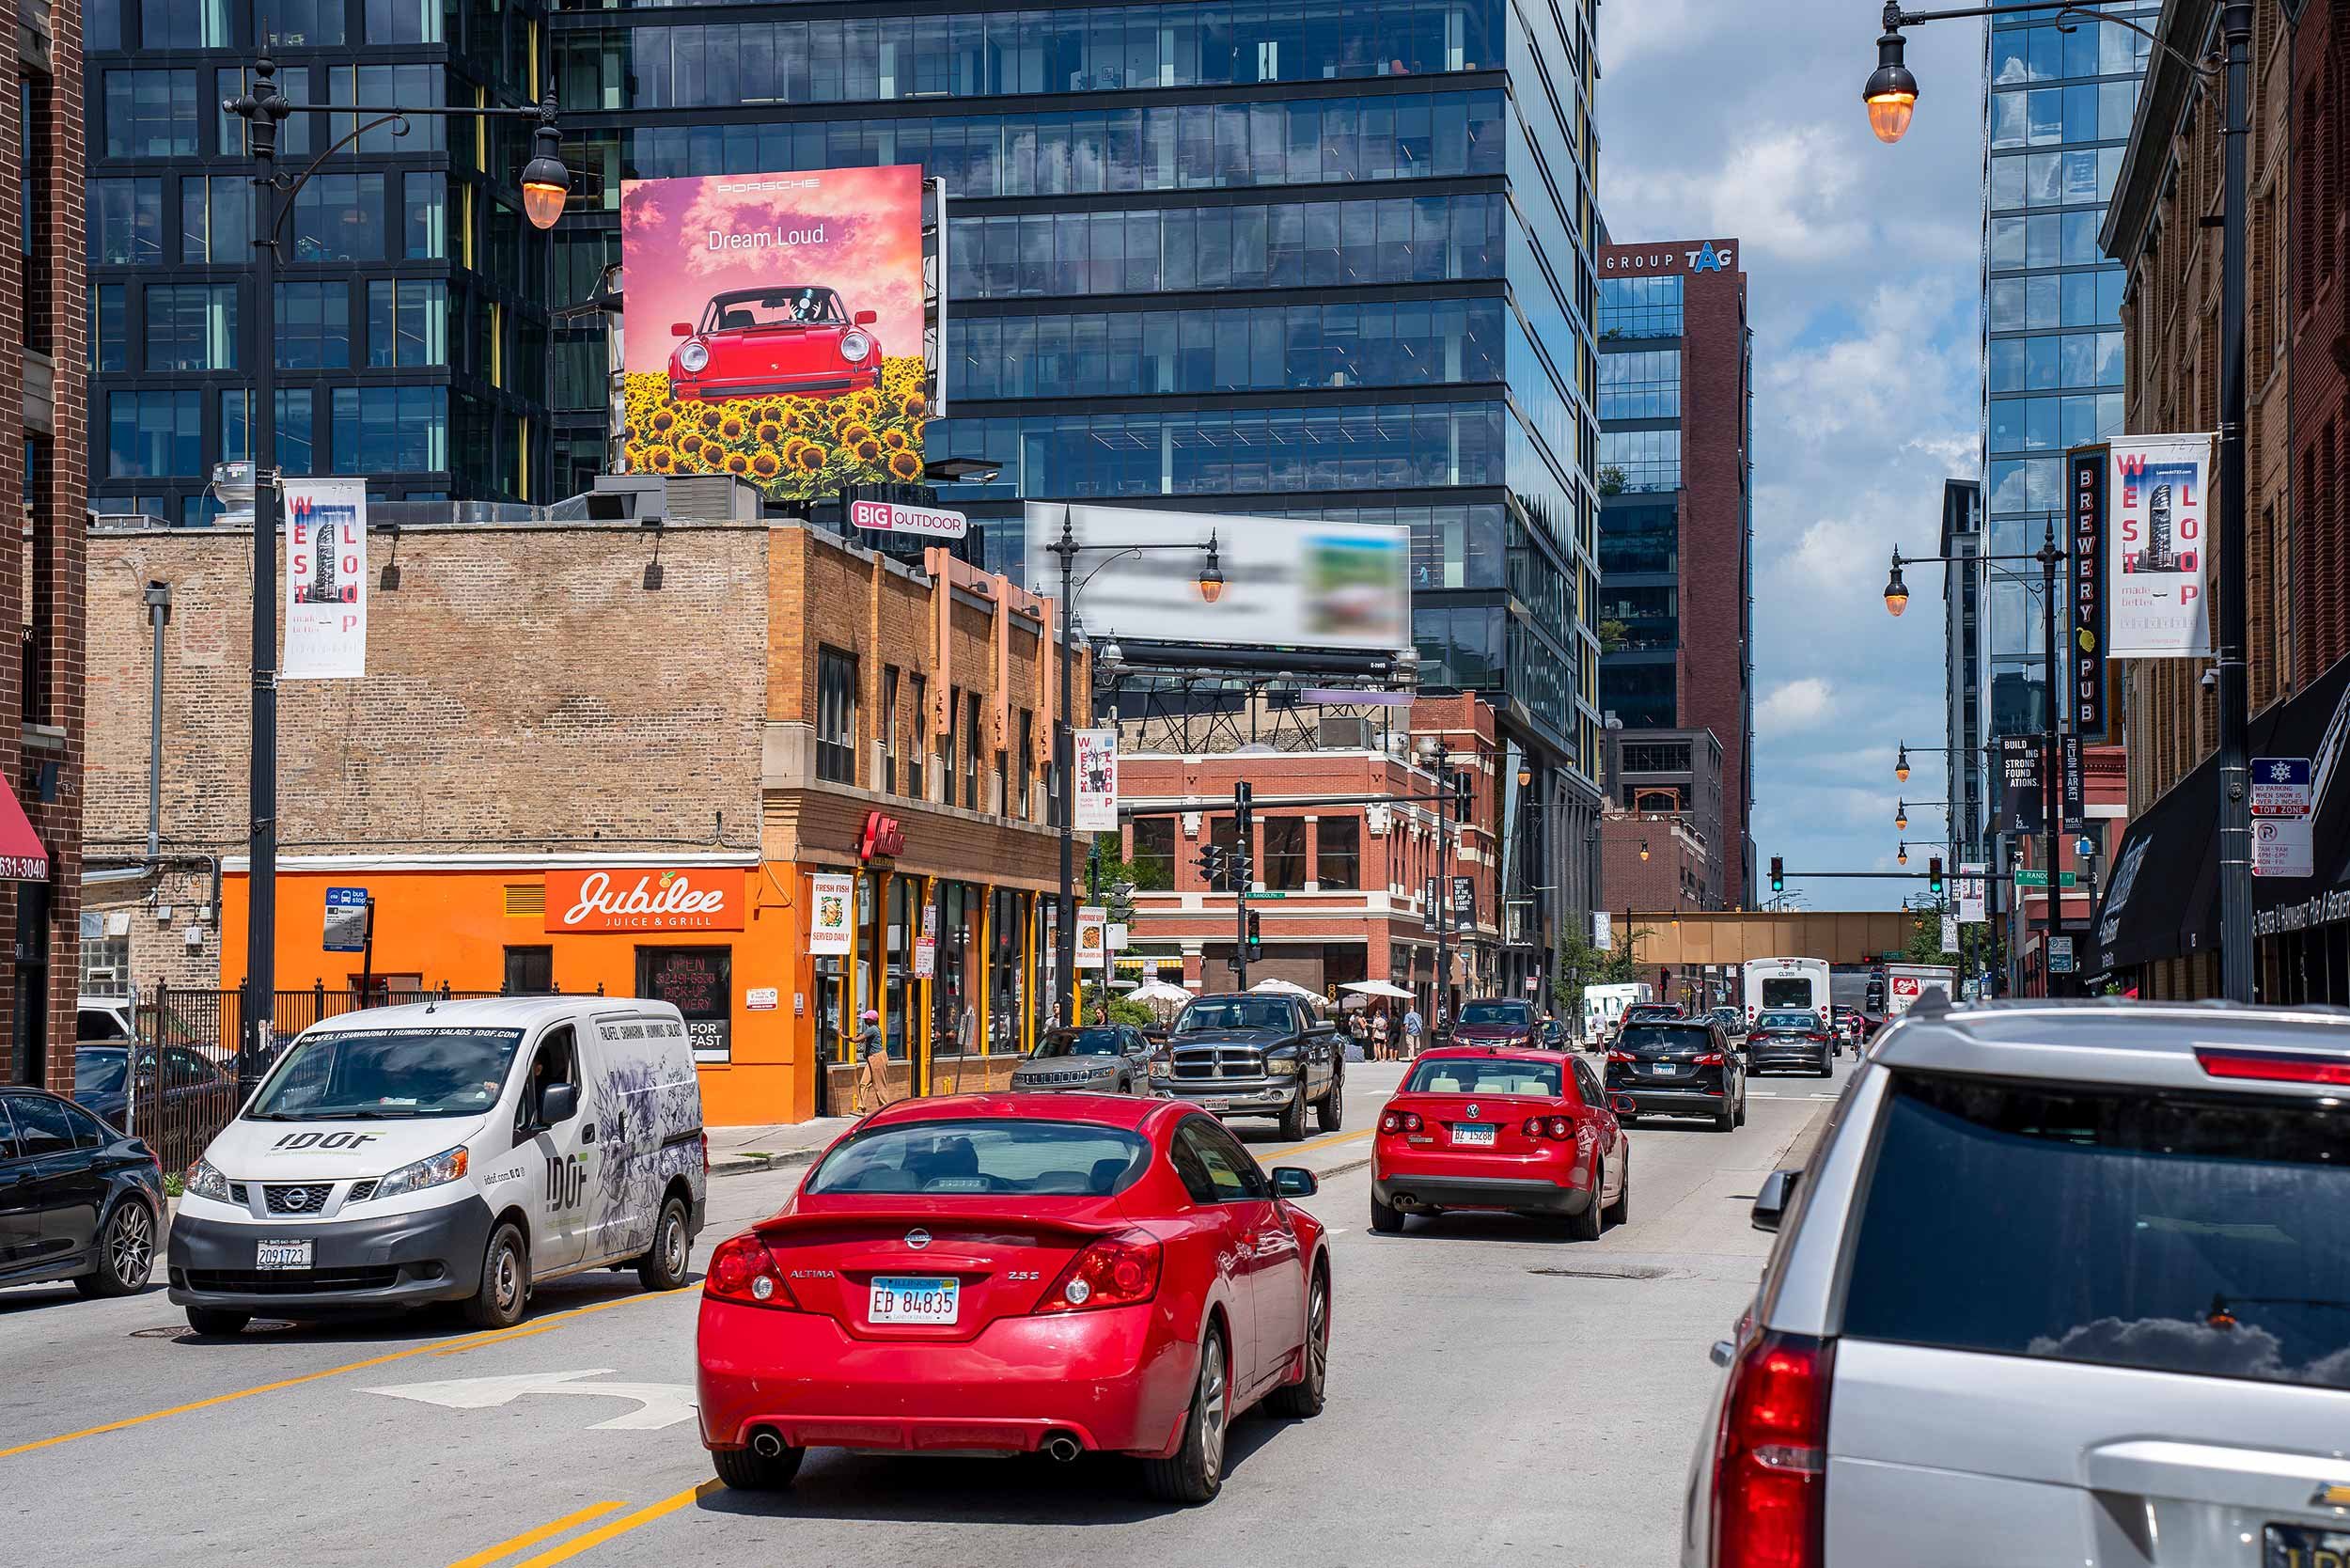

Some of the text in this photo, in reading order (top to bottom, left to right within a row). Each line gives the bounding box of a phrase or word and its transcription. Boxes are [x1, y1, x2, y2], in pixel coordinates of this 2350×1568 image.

[717, 179, 821, 194] PORSCHE
[709, 224, 828, 250] Dream Loud.
[1606, 242, 1732, 273] GROUP TAG
[857, 506, 962, 532] BIG OUTDOOR
[2115, 453, 2147, 574] WEST
[288, 495, 313, 604] WEST
[2077, 470, 2095, 622] BREWERY
[2180, 484, 2199, 605] LOOP
[342, 525, 359, 633] LOOP
[2080, 659, 2094, 722] PUB
[2004, 740, 2027, 750] BUILD
[2026, 749, 2039, 758] ING
[2005, 759, 2035, 769] STRONG
[2067, 738, 2078, 801] FULTON MARKET
[2005, 768, 2031, 778] FOUND
[2010, 777, 2040, 788] ATIONS.
[2280, 806, 2305, 814] ZONE
[815, 884, 850, 893] FRESH FISH
[564, 872, 725, 925] Jubilee
[605, 917, 712, 927] JUICE & GRILL
[812, 932, 850, 942] SERVED DAILY
[666, 956, 705, 972] OPEN
[300, 1032, 334, 1043] FALAFEL
[340, 1029, 387, 1039] SHAWARMA
[474, 1029, 519, 1039] IDOF.COM
[600, 1026, 620, 1041] FALAFEL
[620, 1025, 646, 1040] SHAWARMA
[666, 1023, 683, 1038] SALADS
[690, 1023, 716, 1034] FOR
[483, 1171, 510, 1185] idof.com
[258, 1248, 304, 1264] 2091723
[790, 1270, 835, 1278] ALTIMA
[873, 1291, 954, 1314] EB 84835
